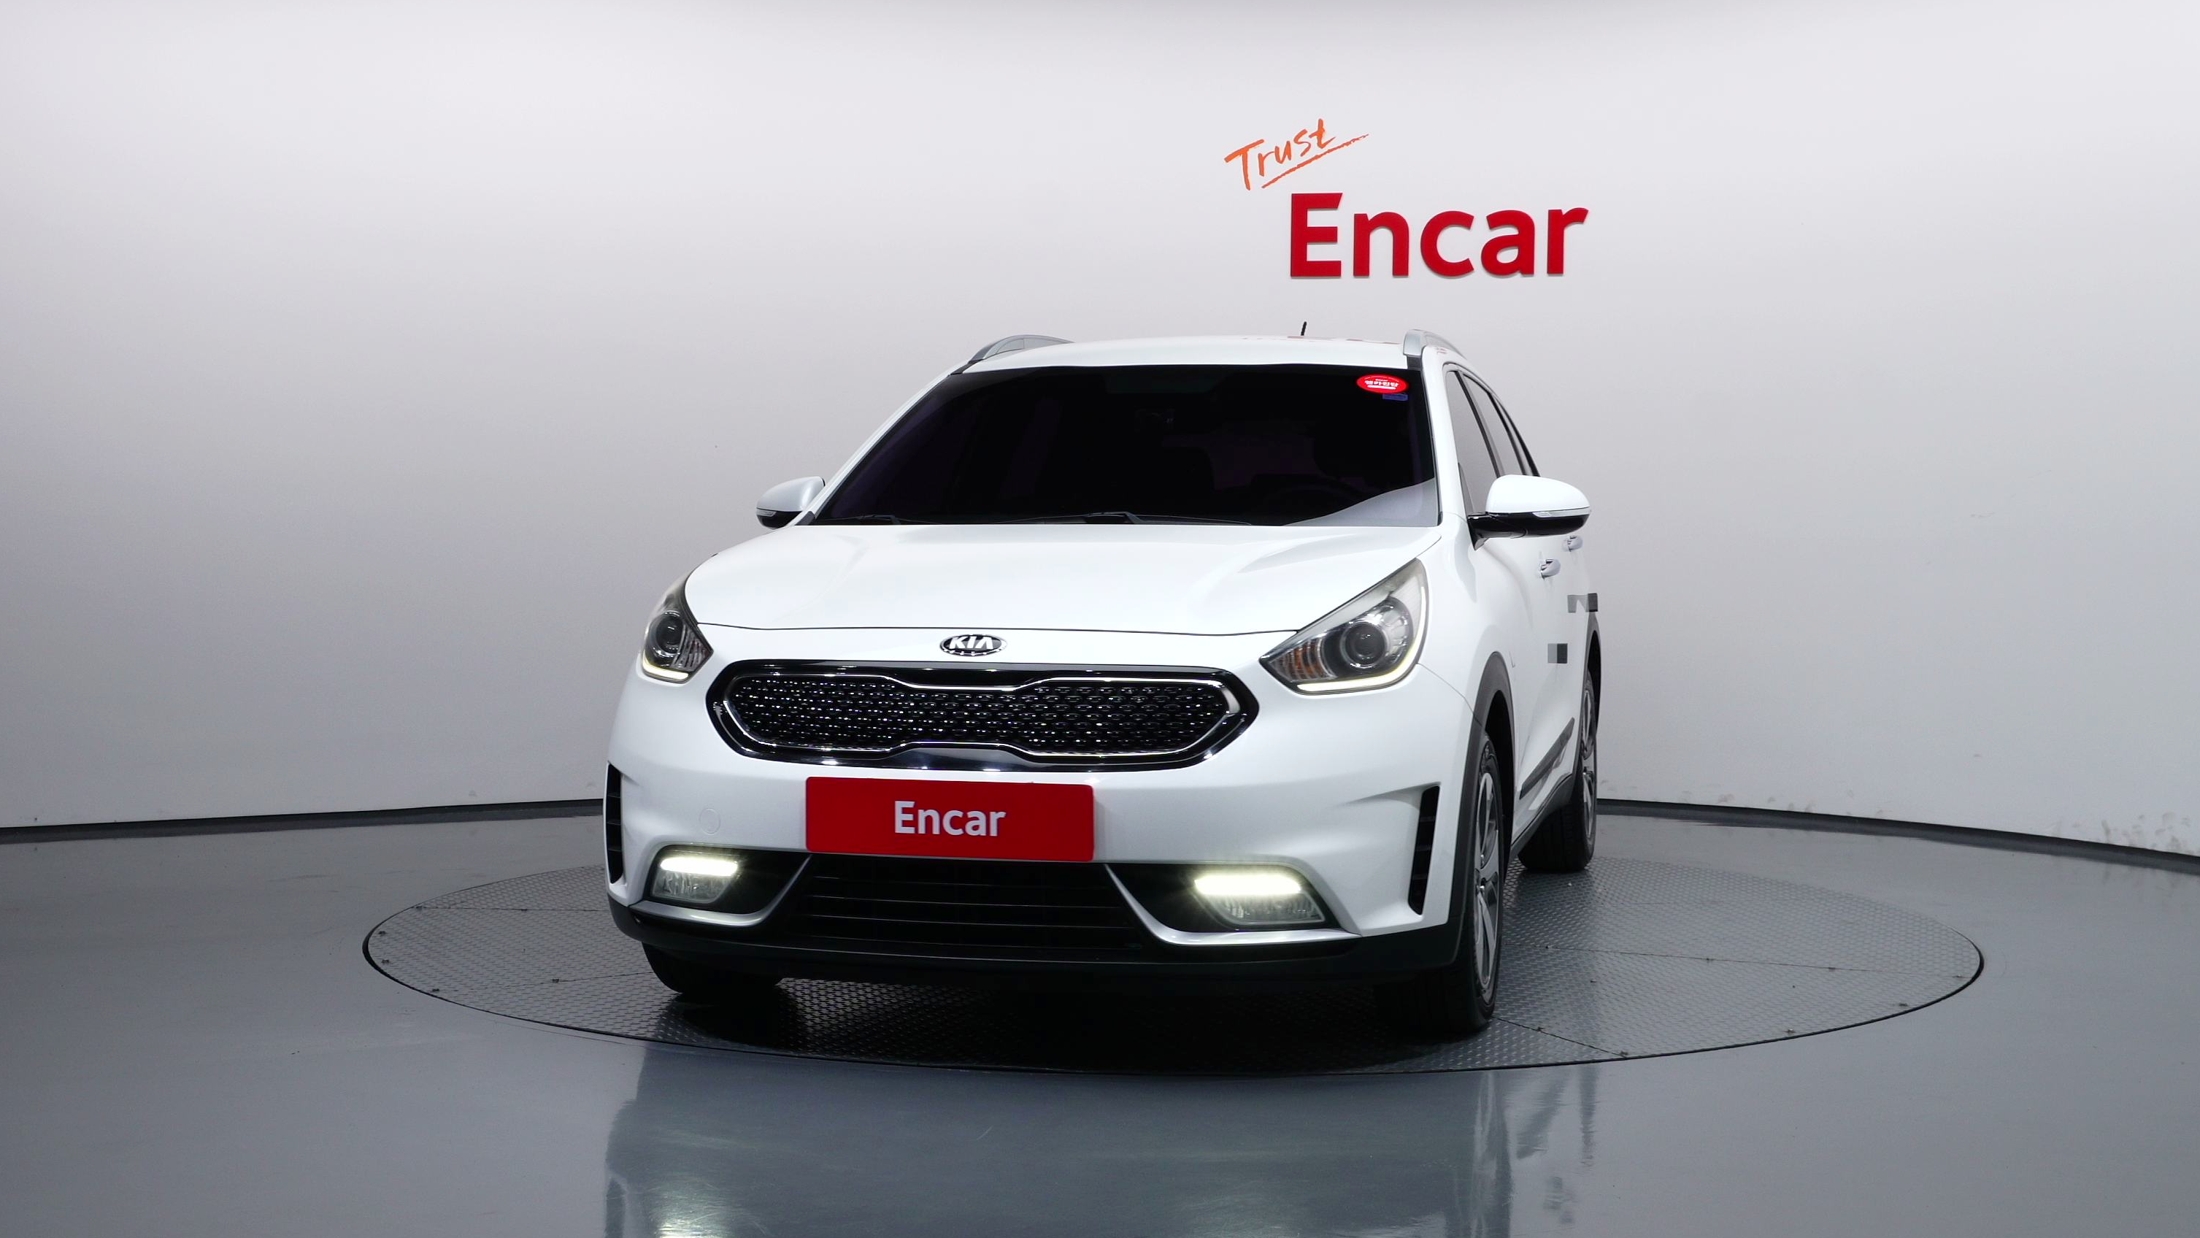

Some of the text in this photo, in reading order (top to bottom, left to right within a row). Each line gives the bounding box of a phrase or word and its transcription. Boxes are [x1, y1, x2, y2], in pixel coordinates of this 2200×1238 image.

[1225, 119, 1337, 191] Trust
[1290, 193, 1589, 278] Encar
[948, 636, 994, 650] KIA
[894, 800, 1006, 837] Encar
